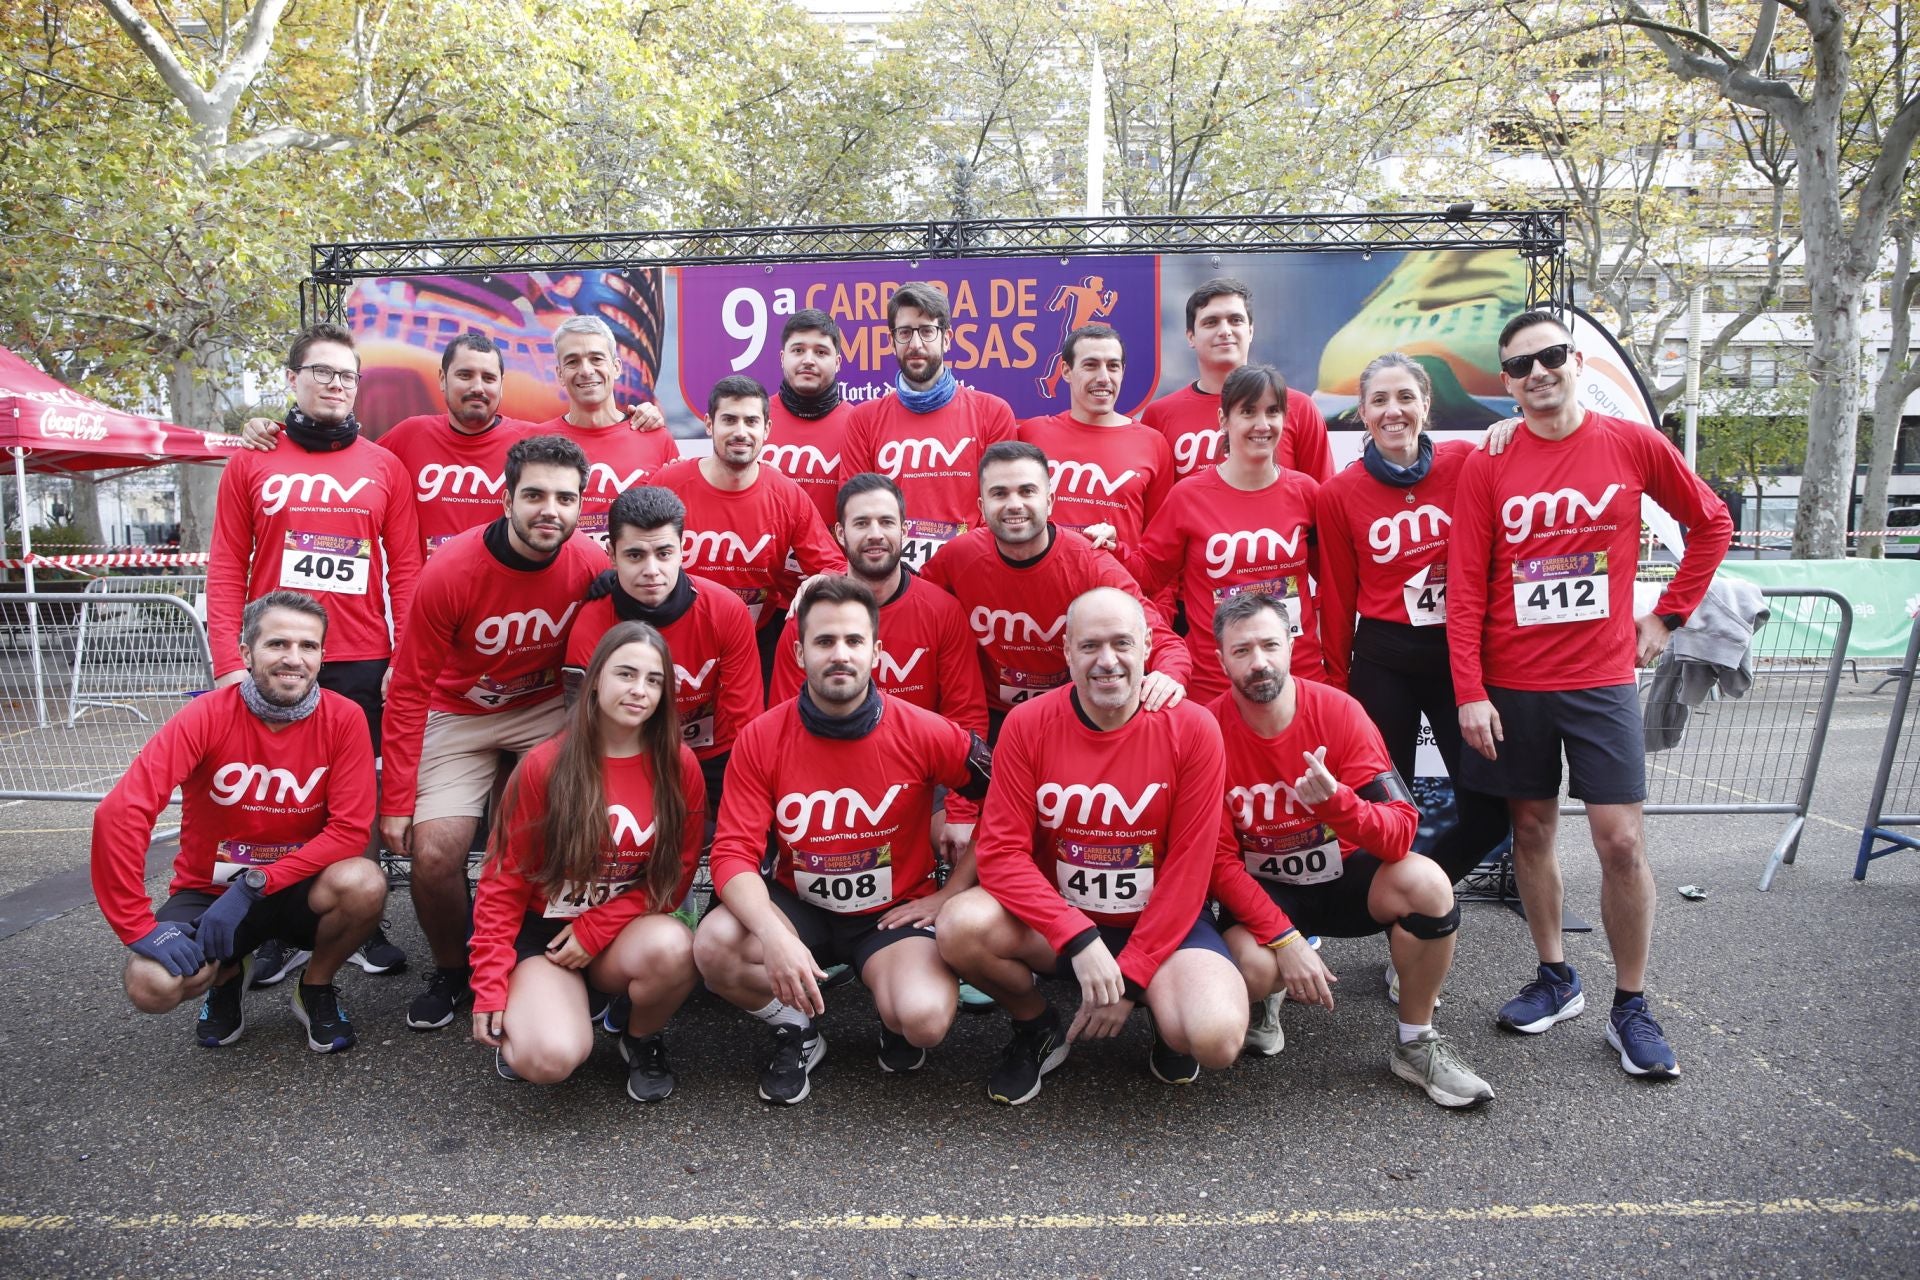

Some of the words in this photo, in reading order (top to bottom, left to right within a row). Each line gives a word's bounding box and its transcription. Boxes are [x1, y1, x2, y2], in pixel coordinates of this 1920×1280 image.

[990, 279, 1037, 317] DE
[839, 322, 1037, 371] MPSAS
[837, 381, 880, 401] Norte
[878, 437, 971, 480] gmv
[417, 463, 506, 502] gmv
[262, 473, 370, 515] gmv
[442, 496, 479, 504] INNOVATING
[1057, 496, 1094, 505] INNOVATING
[1095, 499, 1128, 510] SOLUTIONS
[333, 507, 369, 515] SOLUTIONS
[1502, 483, 1620, 543] gmv
[1533, 529, 1578, 539] INNOVATING
[1580, 524, 1617, 533] SOLUTIONS
[682, 530, 771, 569] gmv
[902, 541, 946, 562] 41
[1205, 525, 1301, 578] gmv
[1404, 540, 1445, 556] INNOVATING
[294, 555, 354, 581] 405
[1236, 565, 1278, 575] INNOVATING
[1542, 557, 1569, 565] CARRERA
[1542, 562, 1578, 572] EMPRESAS
[1527, 579, 1595, 610] 412
[1823, 601, 1876, 618] Unaja
[475, 602, 578, 655] gmv
[969, 606, 1067, 646] gmv
[889, 684, 923, 693] SOLUTIONS
[210, 762, 328, 806] gmv
[242, 804, 286, 813] INNOVATING
[288, 802, 323, 813] SOLUTIONS
[776, 784, 902, 843] gmv
[1036, 782, 1161, 829] gmv
[810, 832, 858, 842] INNOVATING
[860, 825, 899, 838] SOLUTIONS
[1066, 828, 1113, 837] INNOVATING
[1115, 829, 1157, 837] SOLUTIONS
[1256, 819, 1300, 832] INNOVATING
[1084, 846, 1111, 854] CARRERA
[1084, 853, 1121, 862] EMPRESAS
[824, 860, 860, 868] EMPRESAS
[1259, 850, 1326, 876] 400
[808, 873, 876, 900] 408
[1067, 869, 1137, 900] 415
